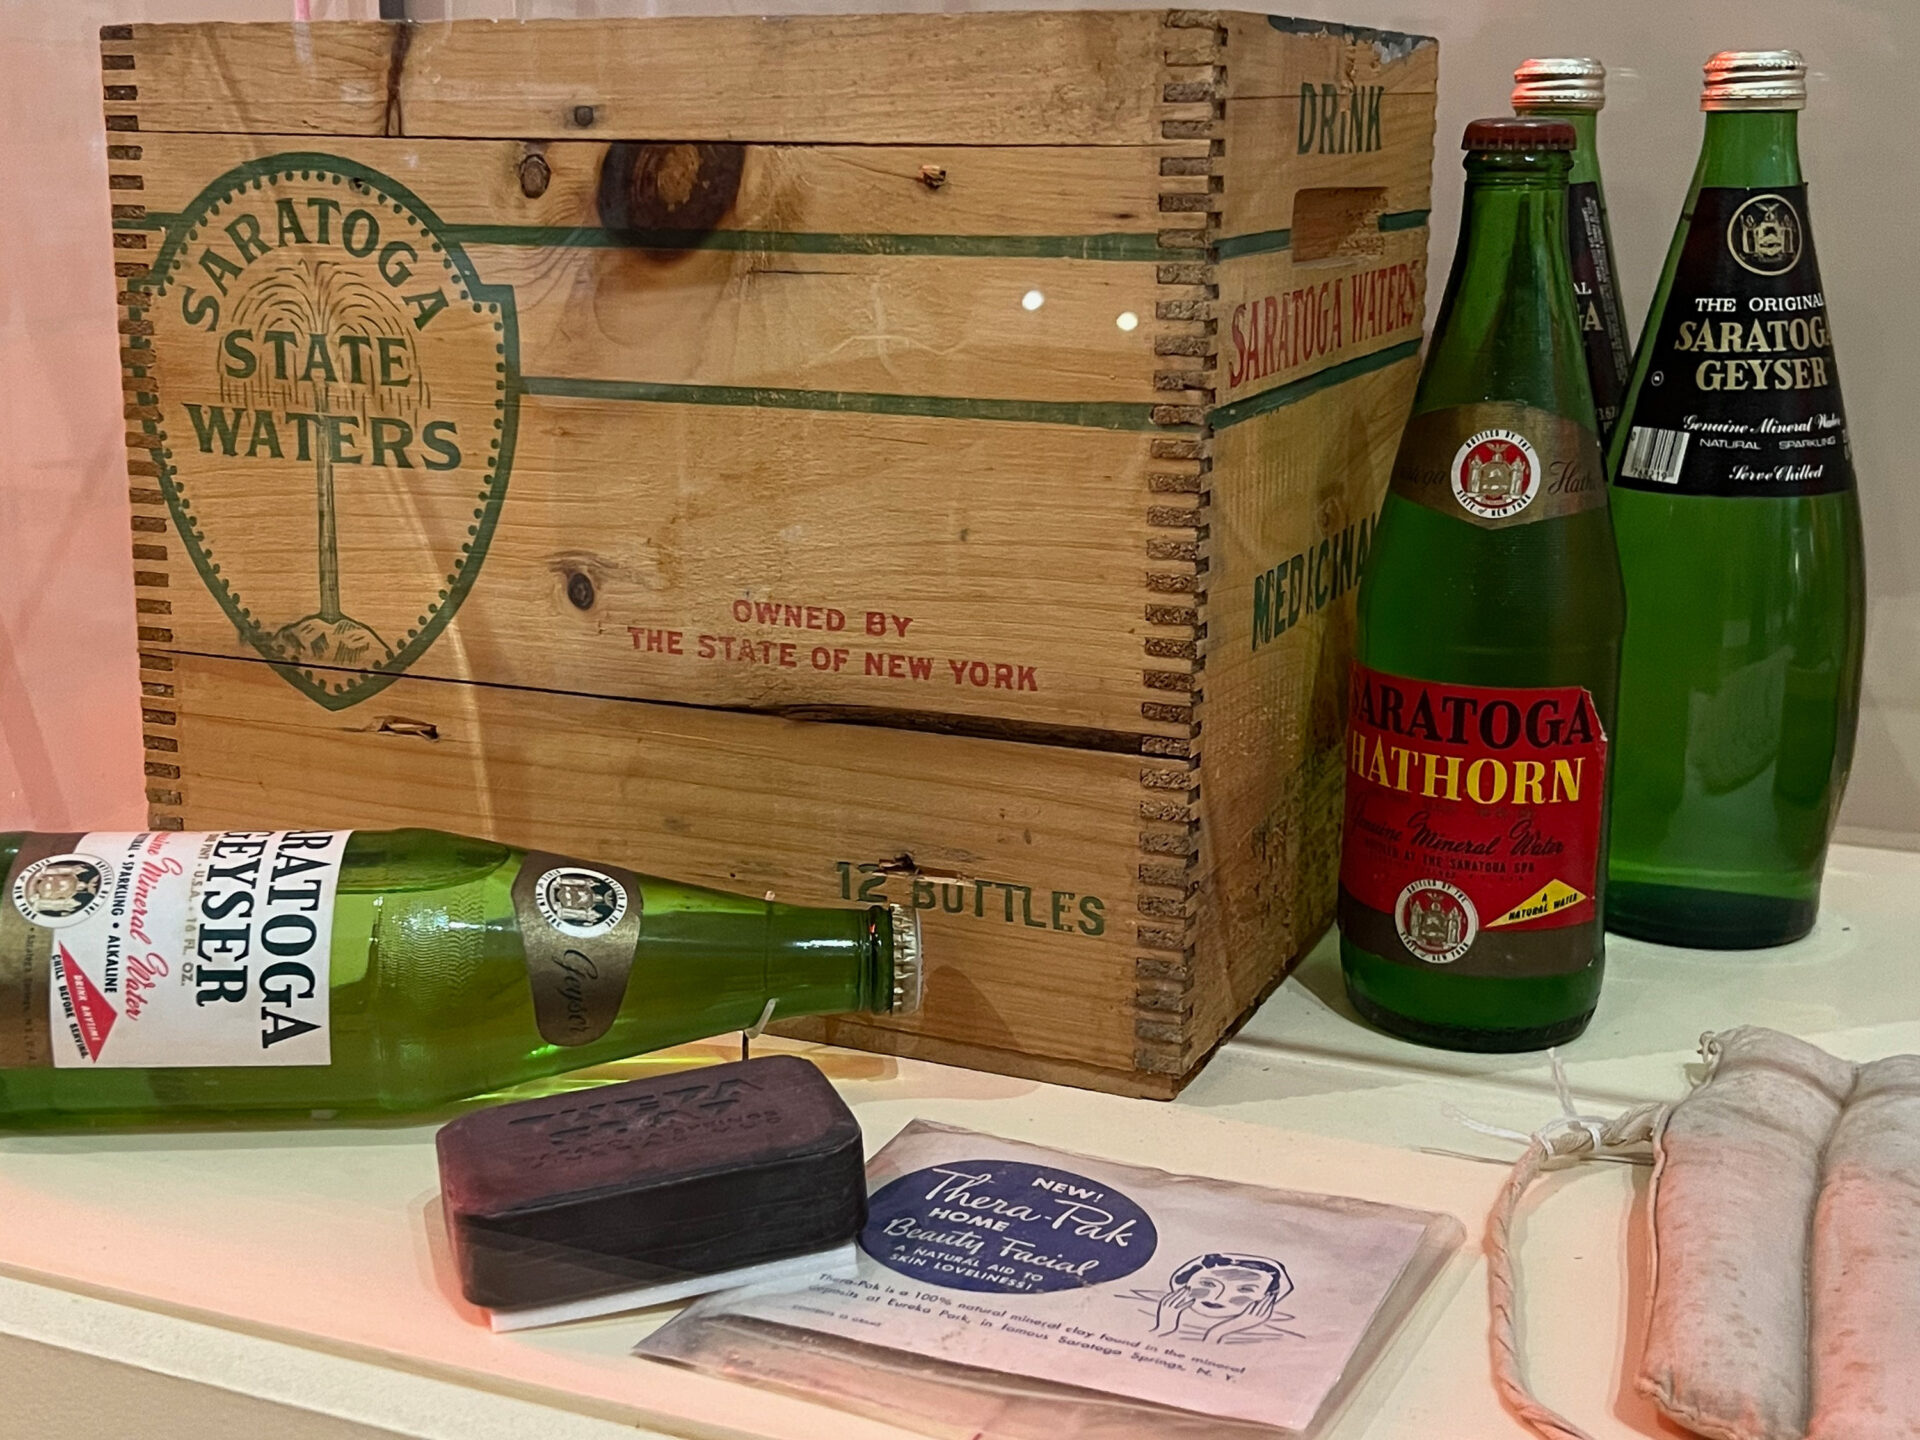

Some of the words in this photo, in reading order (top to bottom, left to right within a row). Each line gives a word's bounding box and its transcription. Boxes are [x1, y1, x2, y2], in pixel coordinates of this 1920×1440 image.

[1297, 82, 1384, 155] DRINK
[182, 197, 449, 332] SARATOGA
[1230, 278, 1343, 388] SARATOGA
[1351, 260, 1418, 343] WATERS
[1695, 298, 1736, 312] THE
[1749, 293, 1824, 312] ORIGINAL
[223, 330, 413, 387] STATE
[1695, 357, 1828, 391] GEYSER
[183, 403, 461, 471] WATERS
[1683, 414, 1748, 434] Genuine
[1750, 417, 1813, 434] Mineral
[1699, 438, 1761, 450] NATURAL
[1779, 436, 1836, 449] SPARKLING
[1729, 464, 1774, 481] Serve
[1775, 464, 1823, 481] Chilled
[1252, 512, 1377, 651] MEDICINA
[733, 600, 845, 632] OWNED
[866, 611, 913, 638] BY
[627, 626, 683, 655] THE
[698, 635, 797, 668] STATE
[811, 647, 850, 672] OF
[865, 652, 934, 680] NEW
[948, 659, 1038, 692] YORK
[1352, 730, 1585, 805] HATHORN
[1407, 810, 1502, 856] Mineral
[1508, 819, 1565, 856] Water
[111, 861, 135, 917] SPARKLING
[130, 857, 183, 945] Mineral
[837, 861, 888, 902] 12
[912, 878, 1105, 936] BOTTLES
[1508, 905, 1549, 920] NATURAL
[1553, 893, 1578, 910] WATER
[1541, 893, 1548, 902] A
[196, 830, 275, 1008] GEYSER
[52, 954, 65, 980] CHILL
[59, 985, 75, 1018] BEFORE
[73, 974, 88, 1001] DRINK
[104, 935, 121, 993] ALKALINE
[126, 952, 168, 1021] Water
[551, 949, 598, 1032] Geyser
[925, 1168, 1137, 1247] Thera-Pak
[1031, 1177, 1104, 1203] NEW!
[883, 1218, 985, 1256] Beauty
[1000, 1236, 1100, 1277] Facial
[928, 1207, 1011, 1233] HOME
[889, 1252, 927, 1267] SKIN
[934, 1262, 1032, 1291] LOVELINESS!
[915, 1246, 980, 1268] NATURAL
[988, 1264, 1015, 1276] AID
[1024, 1272, 1044, 1282] TO
[885, 1286, 895, 1294] is
[915, 1291, 952, 1306] 100%
[958, 1302, 1007, 1317] natural
[1010, 1313, 1062, 1331] mineral
[1065, 1325, 1095, 1340] clay
[1100, 1333, 1141, 1348] found
[1145, 1344, 1158, 1352] in
[1164, 1348, 1186, 1360] the
[1191, 1356, 1246, 1374] mineral
[887, 1298, 931, 1314] Eureka
[980, 1317, 993, 1327] in
[1001, 1324, 1049, 1340] famous
[1058, 1335, 1122, 1356] Saratoga
